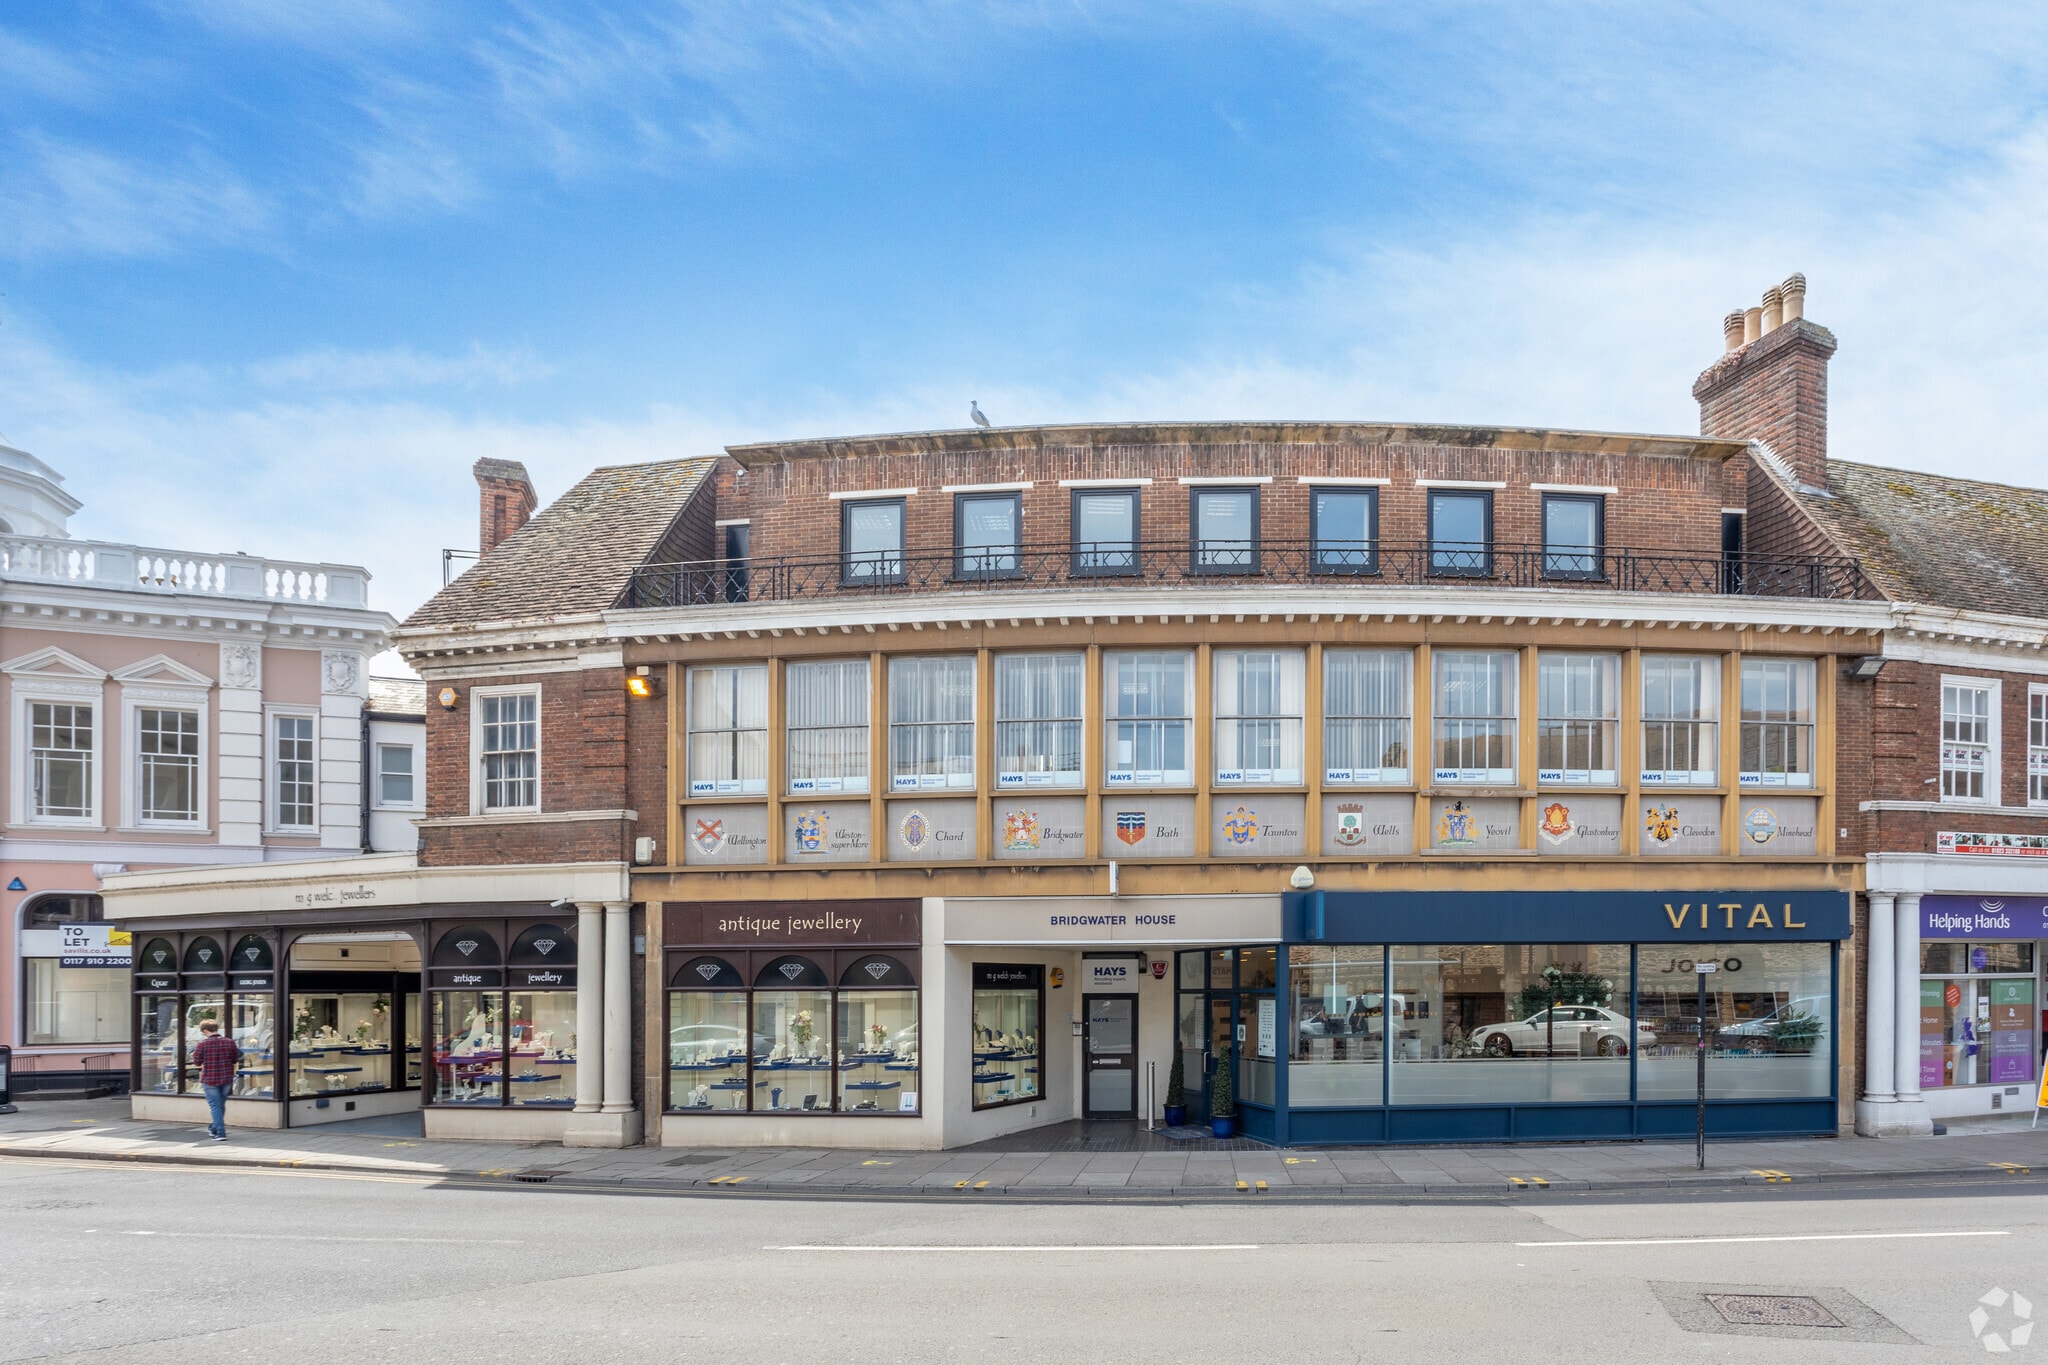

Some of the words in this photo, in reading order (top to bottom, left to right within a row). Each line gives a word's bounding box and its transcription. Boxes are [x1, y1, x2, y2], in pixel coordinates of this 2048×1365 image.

[935, 830, 964, 841] Chard
[1043, 828, 1084, 844] Bridgwater
[1156, 826, 1179, 838] Bath
[1262, 825, 1298, 837] Taunton
[1372, 824, 1400, 836] Wells
[1486, 825, 1511, 839] Yeovil
[1577, 825, 1621, 841] Glastonbury
[1682, 825, 1716, 837] Clevedon
[1777, 826, 1813, 837] Minehead
[727, 835, 767, 849] Wellington
[295, 894, 303, 902] m
[307, 893, 312, 906] g
[314, 887, 336, 901] welc
[340, 885, 376, 904] jewellers
[1050, 916, 1127, 925] BRIDGWATER
[1135, 915, 1176, 925] HOUSE
[1664, 903, 1806, 929] VITAL
[1929, 913, 1973, 932] Helping
[1975, 913, 2010, 929] Hands
[719, 916, 780, 936] antique
[788, 911, 862, 935] jewellery
[64, 928, 83, 936] TO
[64, 938, 90, 946] LET
[1094, 967, 1127, 976] HAYS
[1661, 957, 1742, 973] JOCO
[453, 974, 482, 985] antique
[528, 971, 562, 985] jewellery
